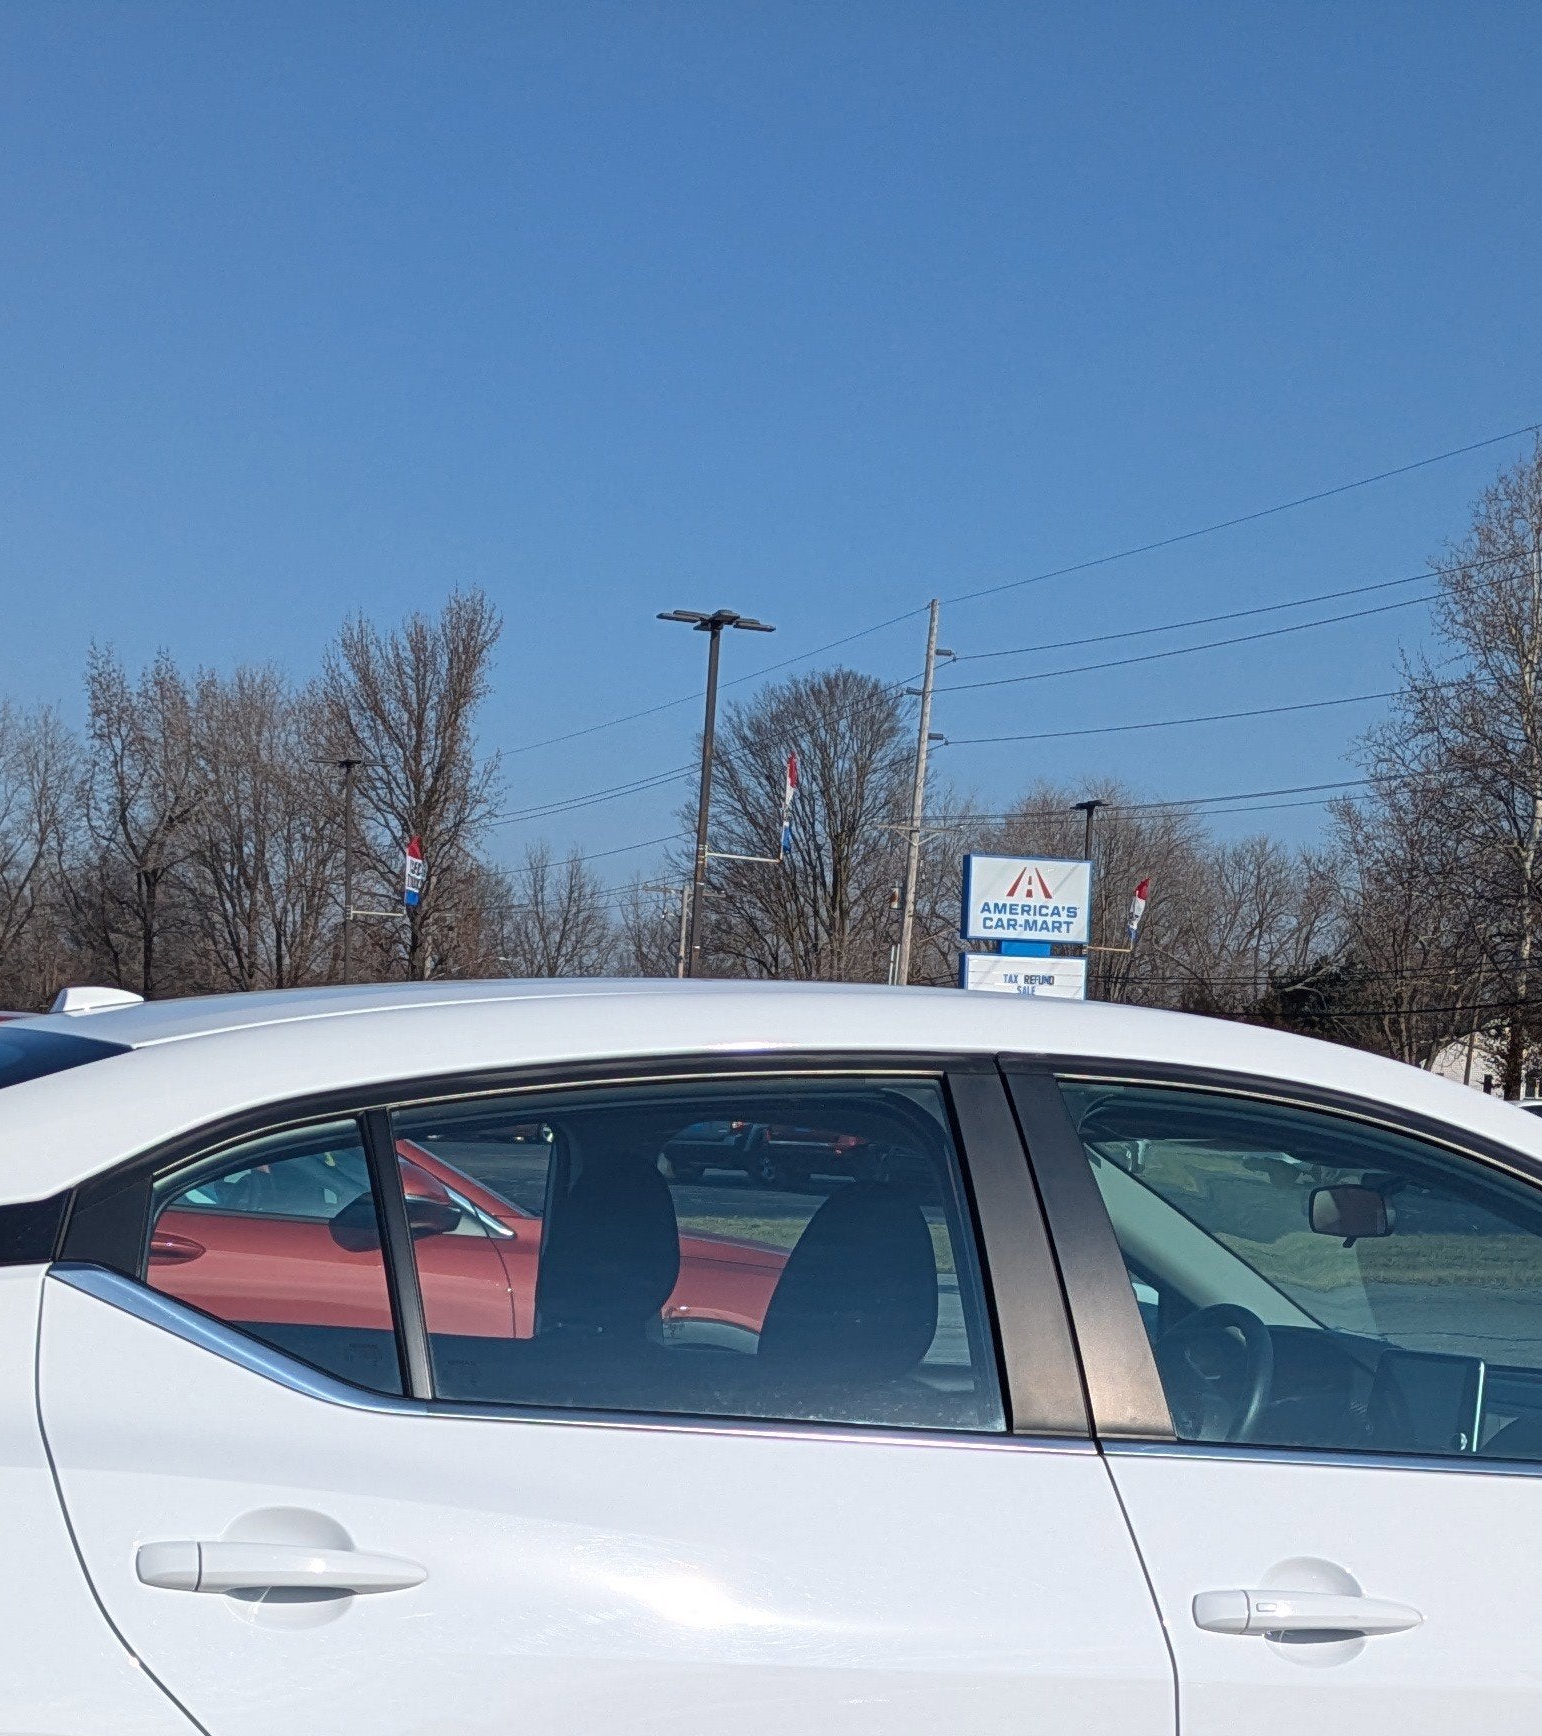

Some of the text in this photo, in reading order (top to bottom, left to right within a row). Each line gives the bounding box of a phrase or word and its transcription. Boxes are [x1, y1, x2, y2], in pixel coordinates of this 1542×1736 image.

[980, 902, 1078, 918] AMERICA'S
[982, 917, 1074, 933] CAR-MART
[1003, 973, 1055, 986] TAX REFUND
